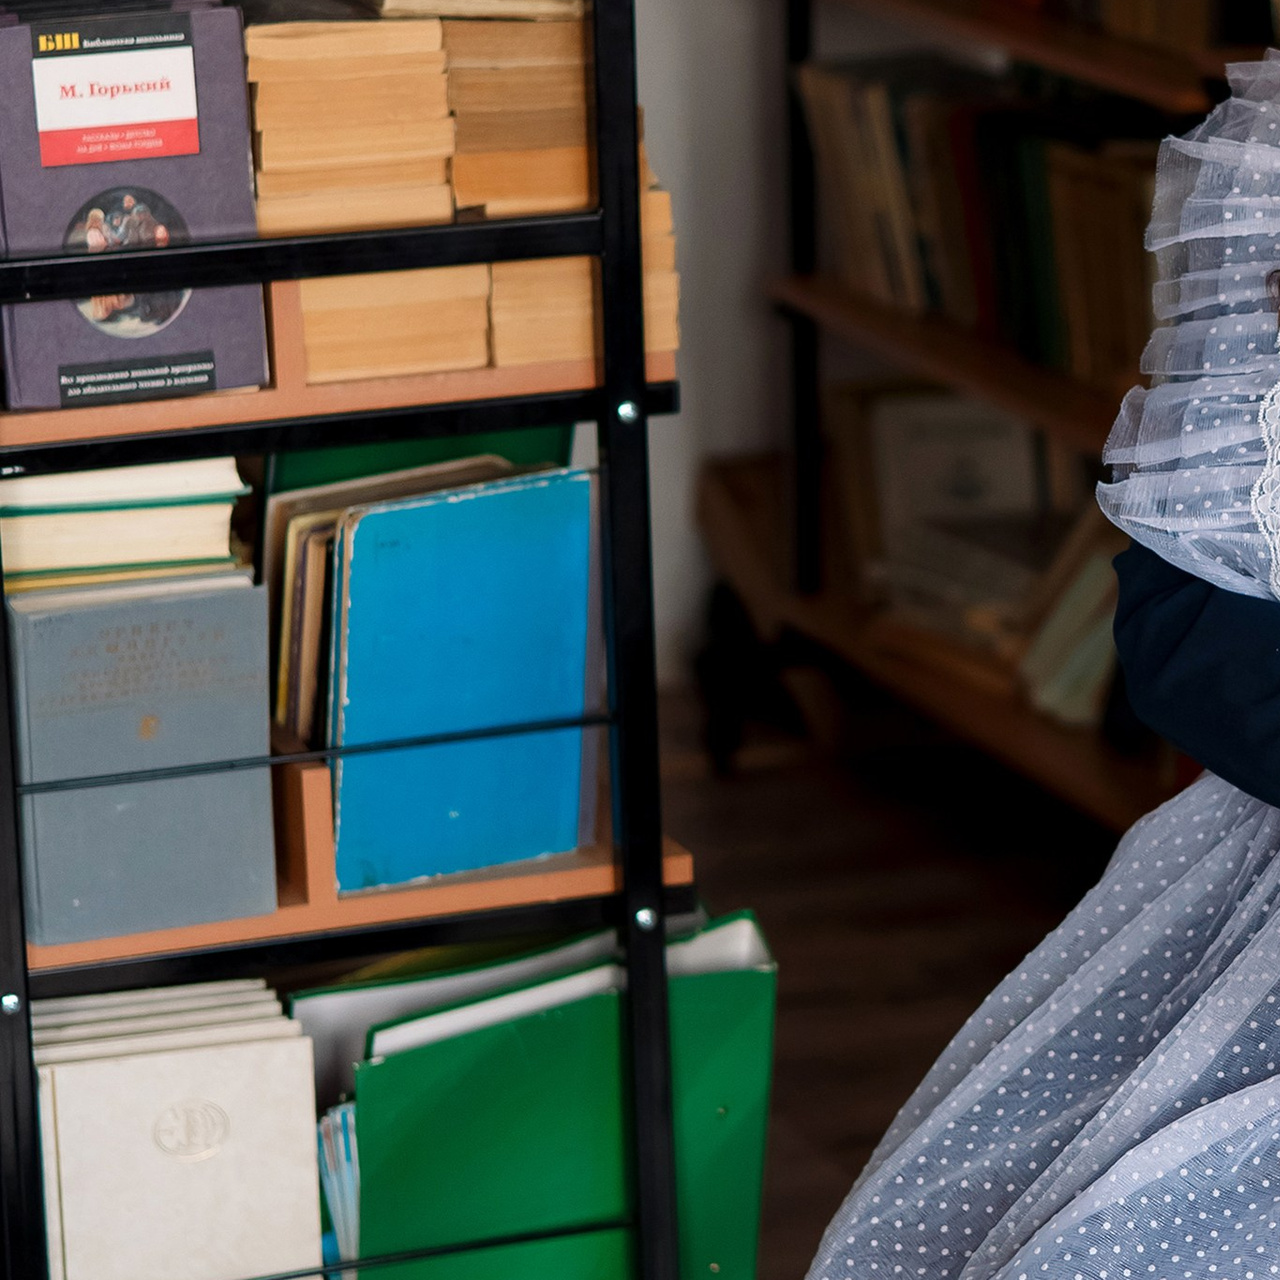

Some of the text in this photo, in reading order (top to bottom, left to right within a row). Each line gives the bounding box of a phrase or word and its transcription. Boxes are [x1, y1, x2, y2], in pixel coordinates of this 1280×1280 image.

[38, 32, 80, 52] БШ
[59, 76, 172, 100] М. Горький
